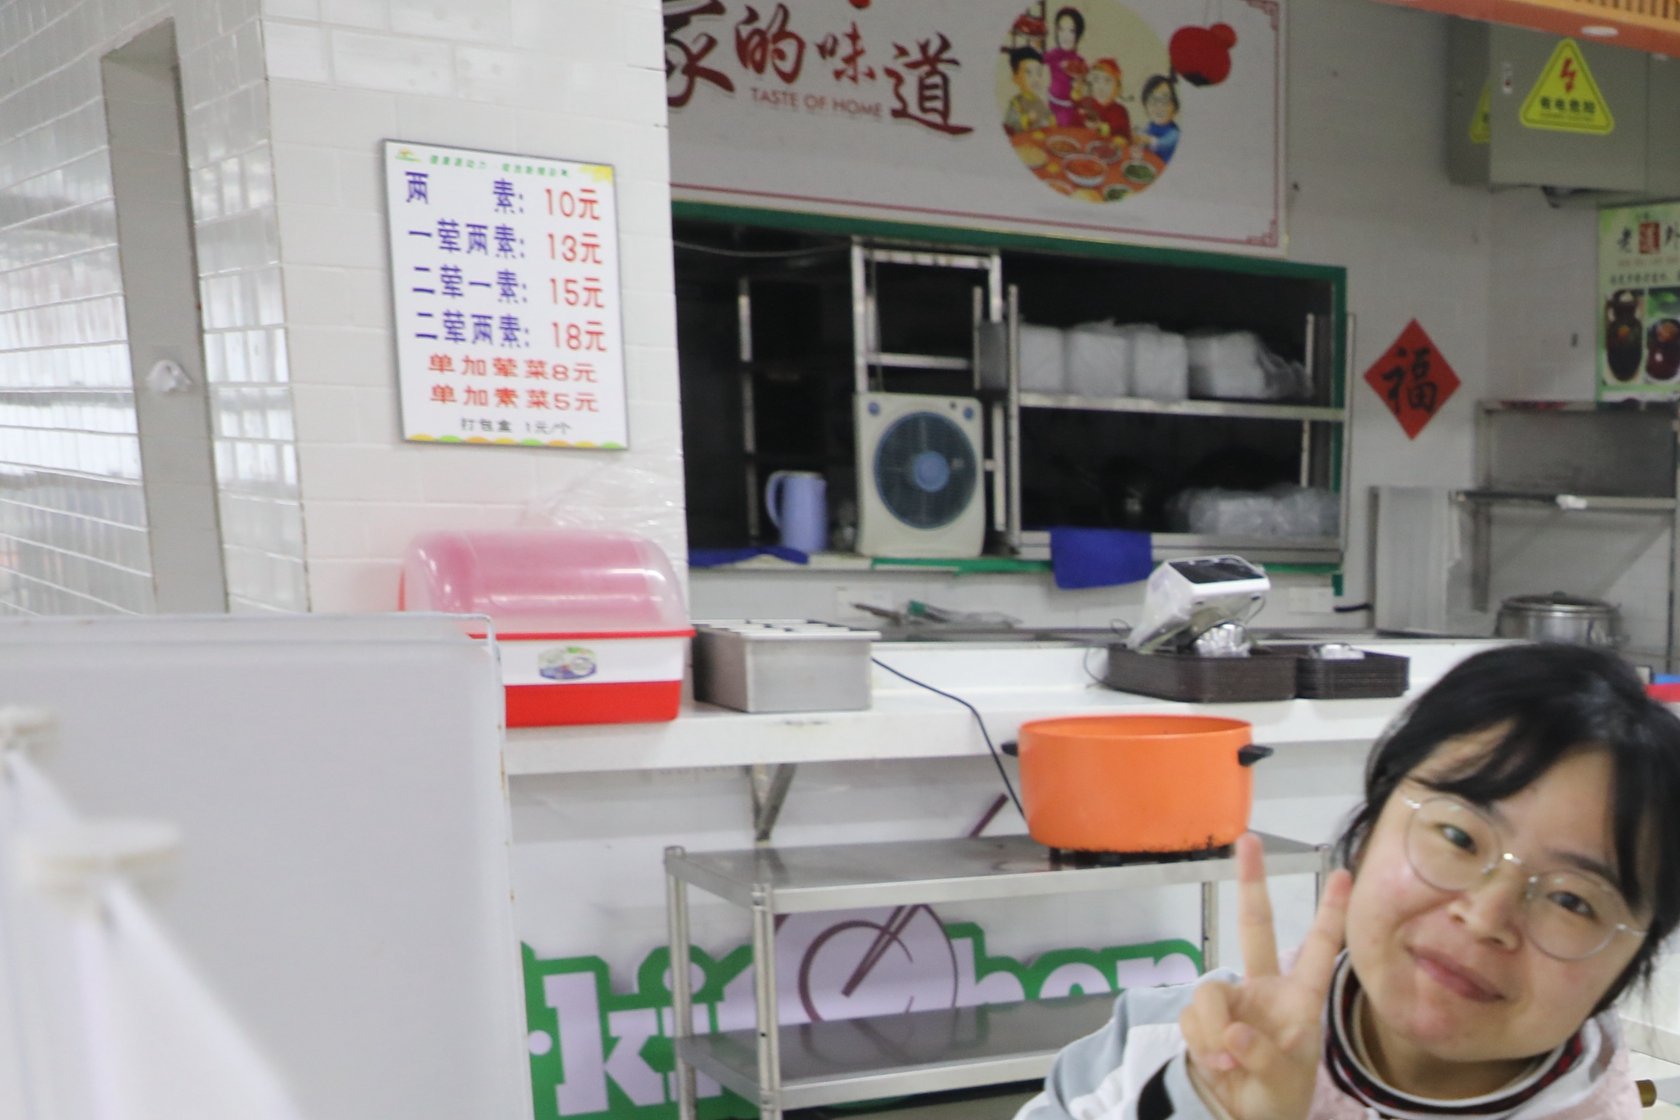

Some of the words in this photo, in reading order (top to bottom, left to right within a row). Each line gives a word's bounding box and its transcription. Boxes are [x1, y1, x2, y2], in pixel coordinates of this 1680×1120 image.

[750, 88, 798, 108] TASTE
[803, 94, 827, 110] OF
[832, 98, 882, 117] HOME
[405, 171, 429, 204] 两
[545, 188, 601, 220] 10元
[548, 233, 603, 264] 13元
[550, 277, 604, 308] 15元
[552, 321, 607, 352] 18元
[428, 353, 598, 383] 单加荤菜8元
[1381, 347, 1438, 414] 福
[430, 384, 599, 412] 单加素菜5元
